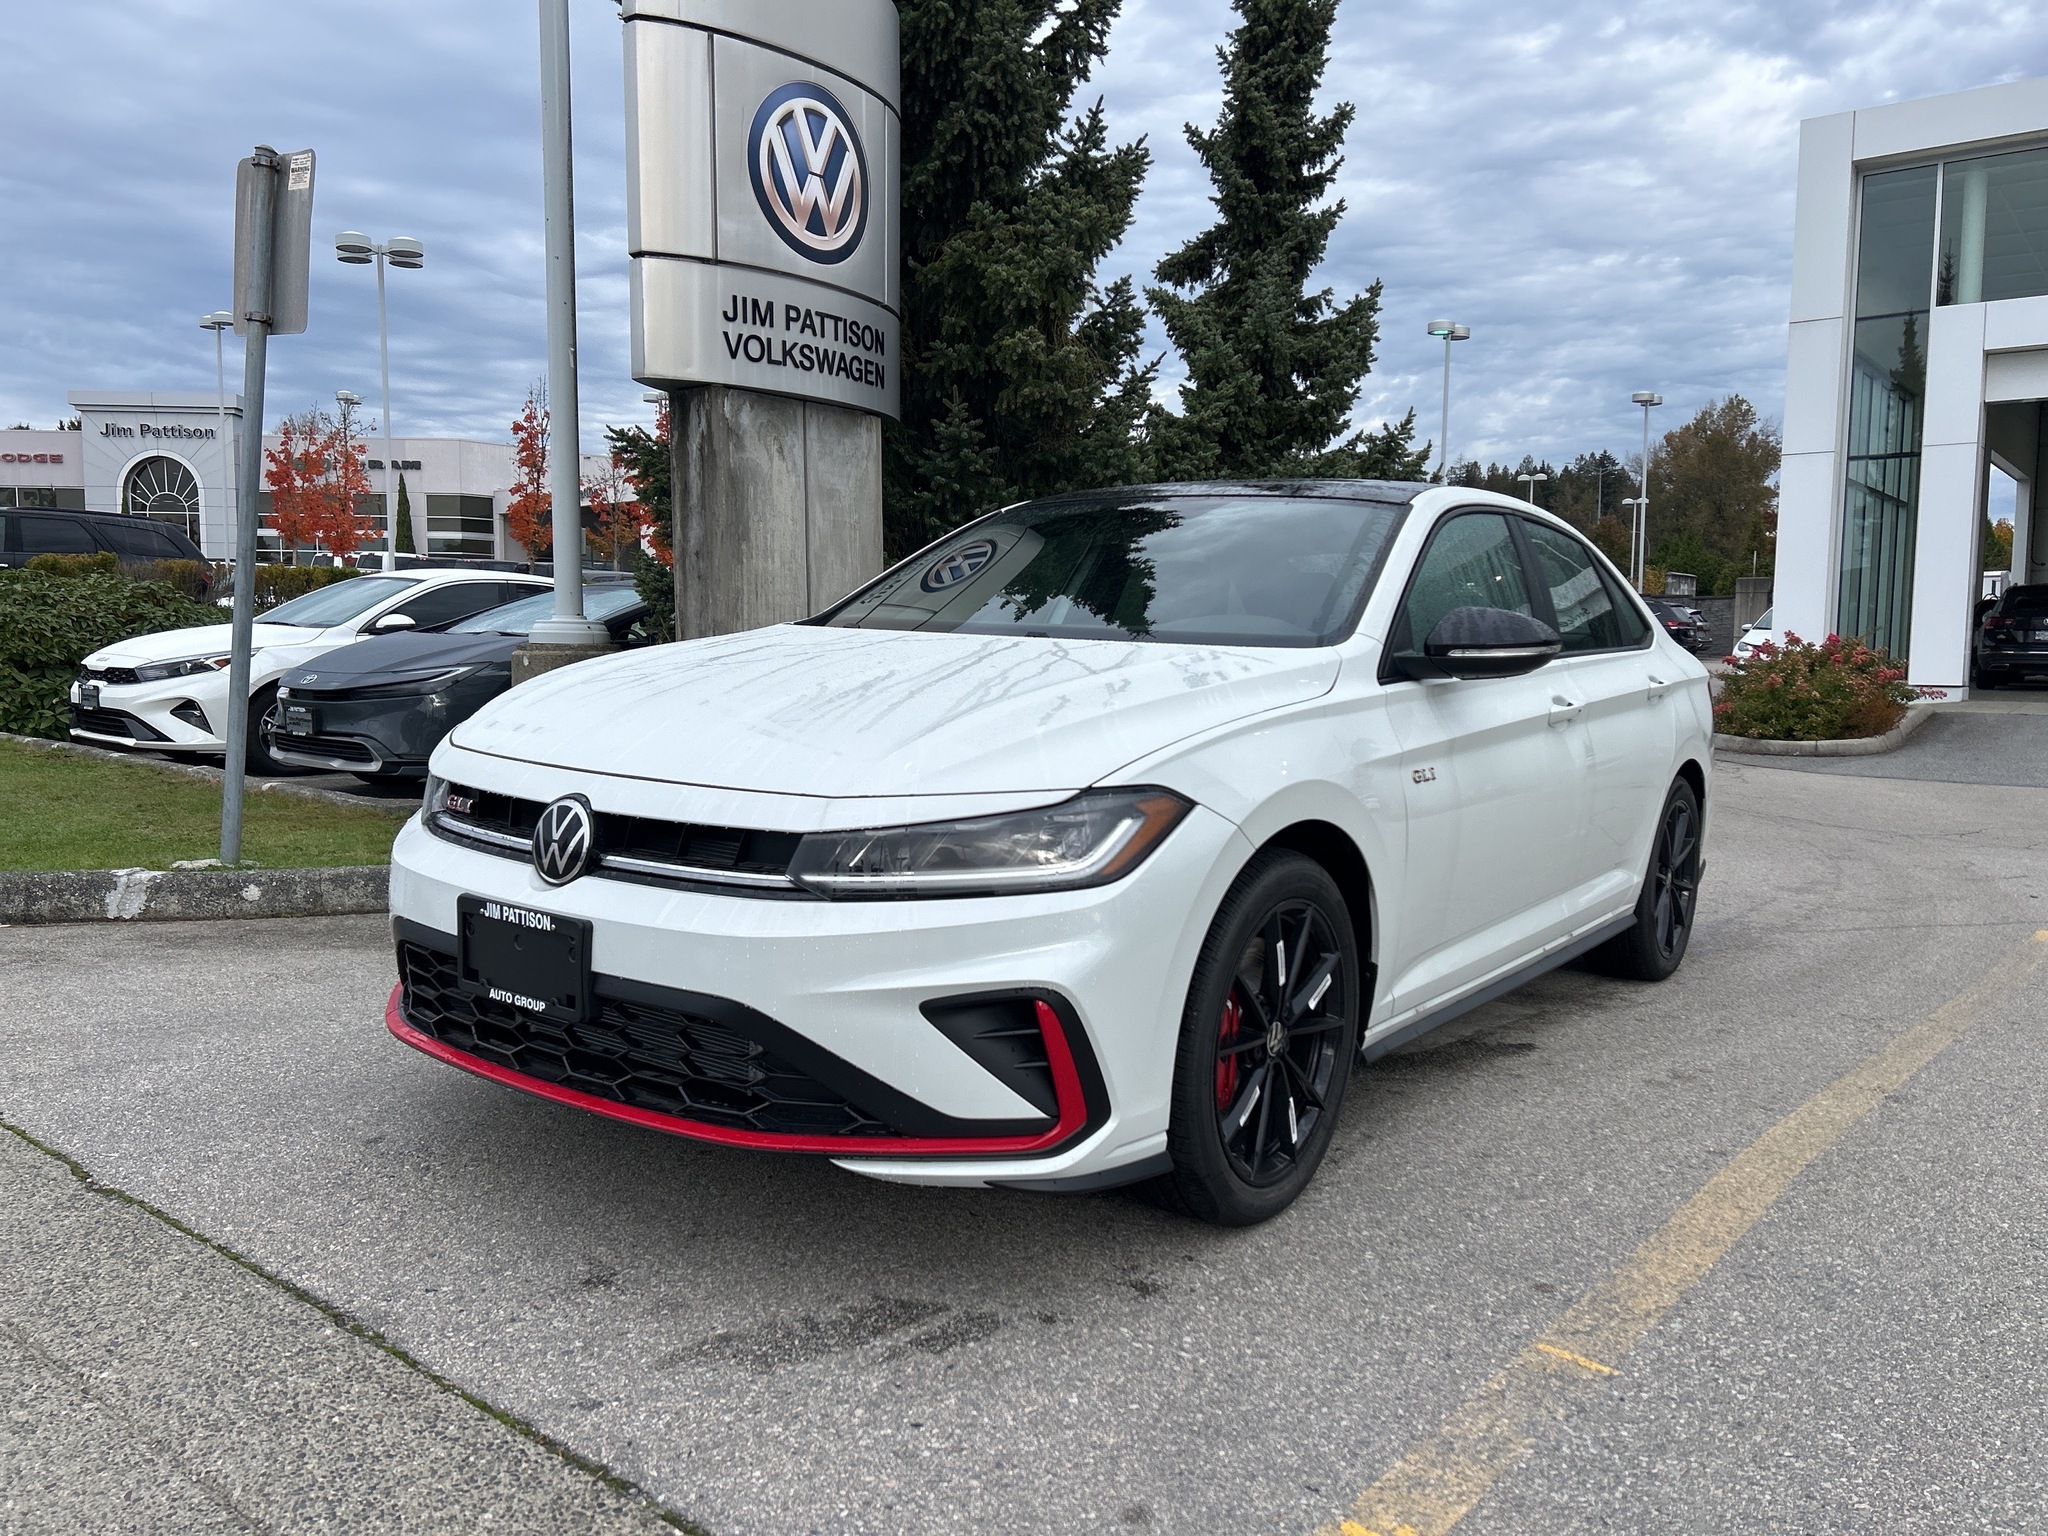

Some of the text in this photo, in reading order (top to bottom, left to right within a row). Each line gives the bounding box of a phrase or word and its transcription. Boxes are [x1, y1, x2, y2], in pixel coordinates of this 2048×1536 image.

[722, 294, 885, 356] JIM PATTISON
[722, 330, 885, 389] VOLKSWAGEN
[100, 422, 216, 440] Jim Pattison
[0, 453, 63, 464] ODGE
[368, 459, 422, 470] RAM
[447, 794, 473, 813] GLI
[484, 902, 551, 931] JIM PATTISON
[489, 988, 546, 1012] AUTO GROUP
